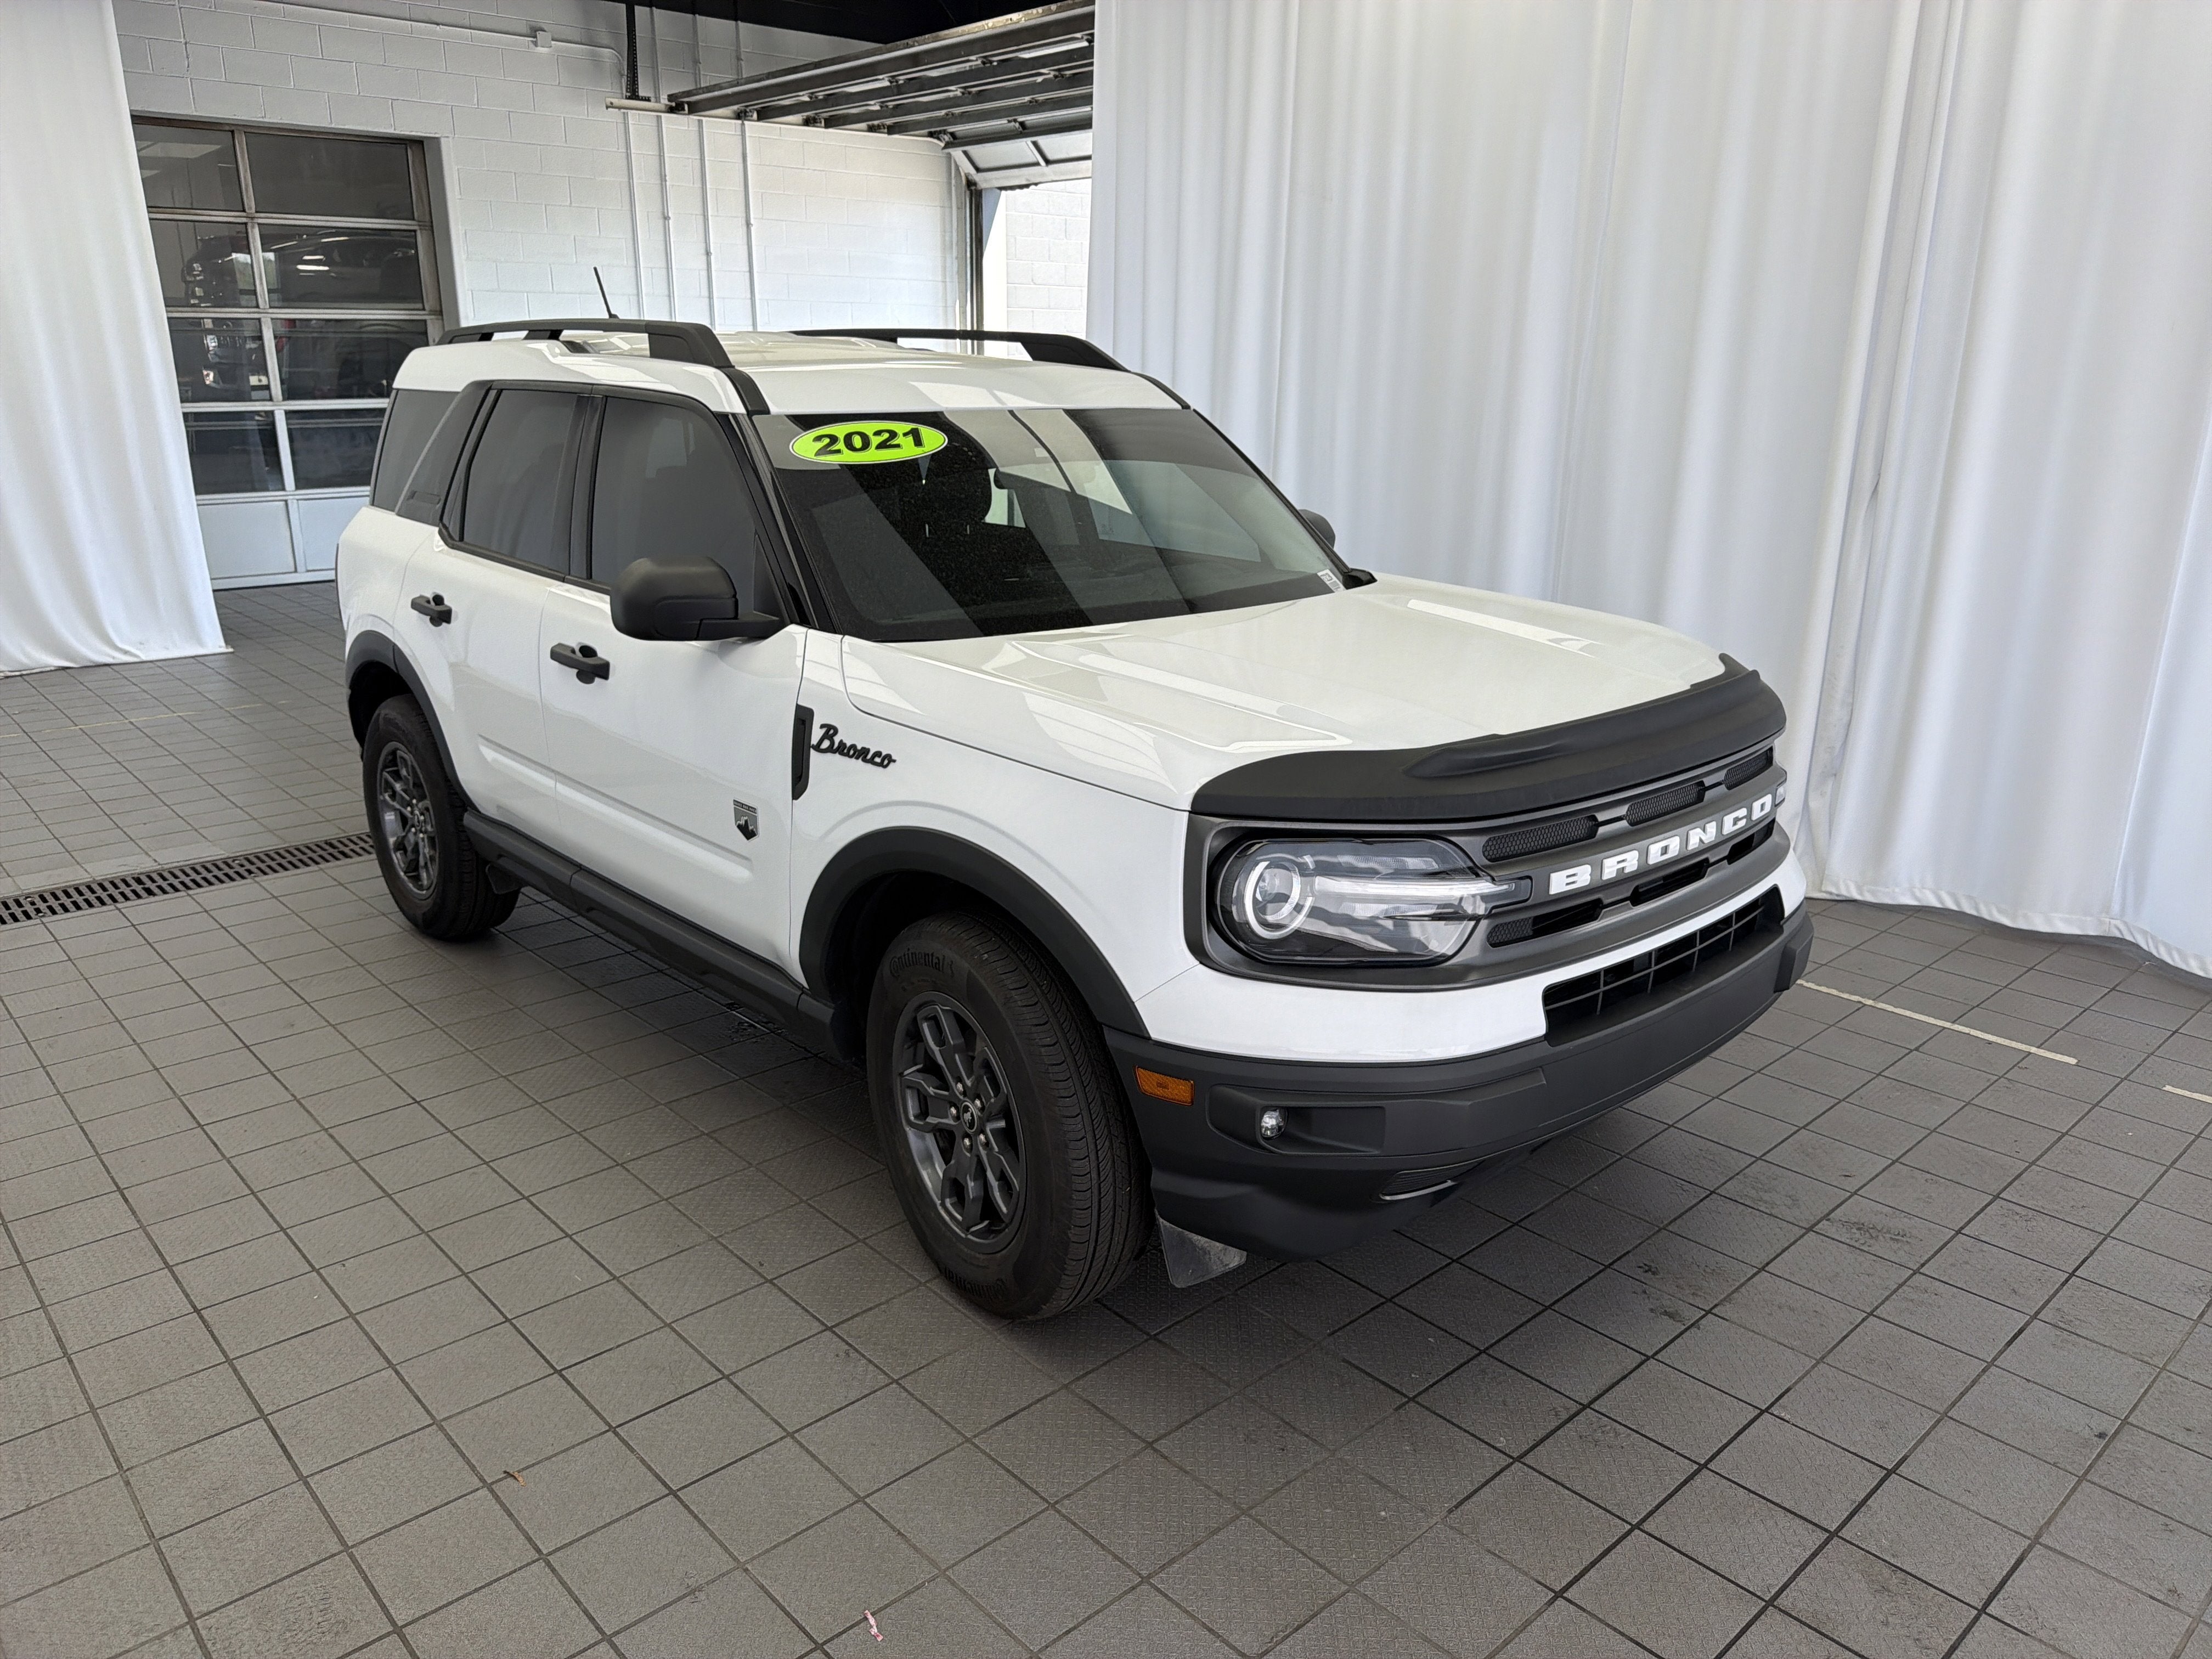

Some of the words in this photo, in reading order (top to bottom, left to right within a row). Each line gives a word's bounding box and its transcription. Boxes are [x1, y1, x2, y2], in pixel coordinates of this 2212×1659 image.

[812, 427, 925, 457] 2021
[810, 723, 896, 769] Bronco
[1549, 793, 1772, 895] BRONCO
[890, 948, 946, 979] Continental
